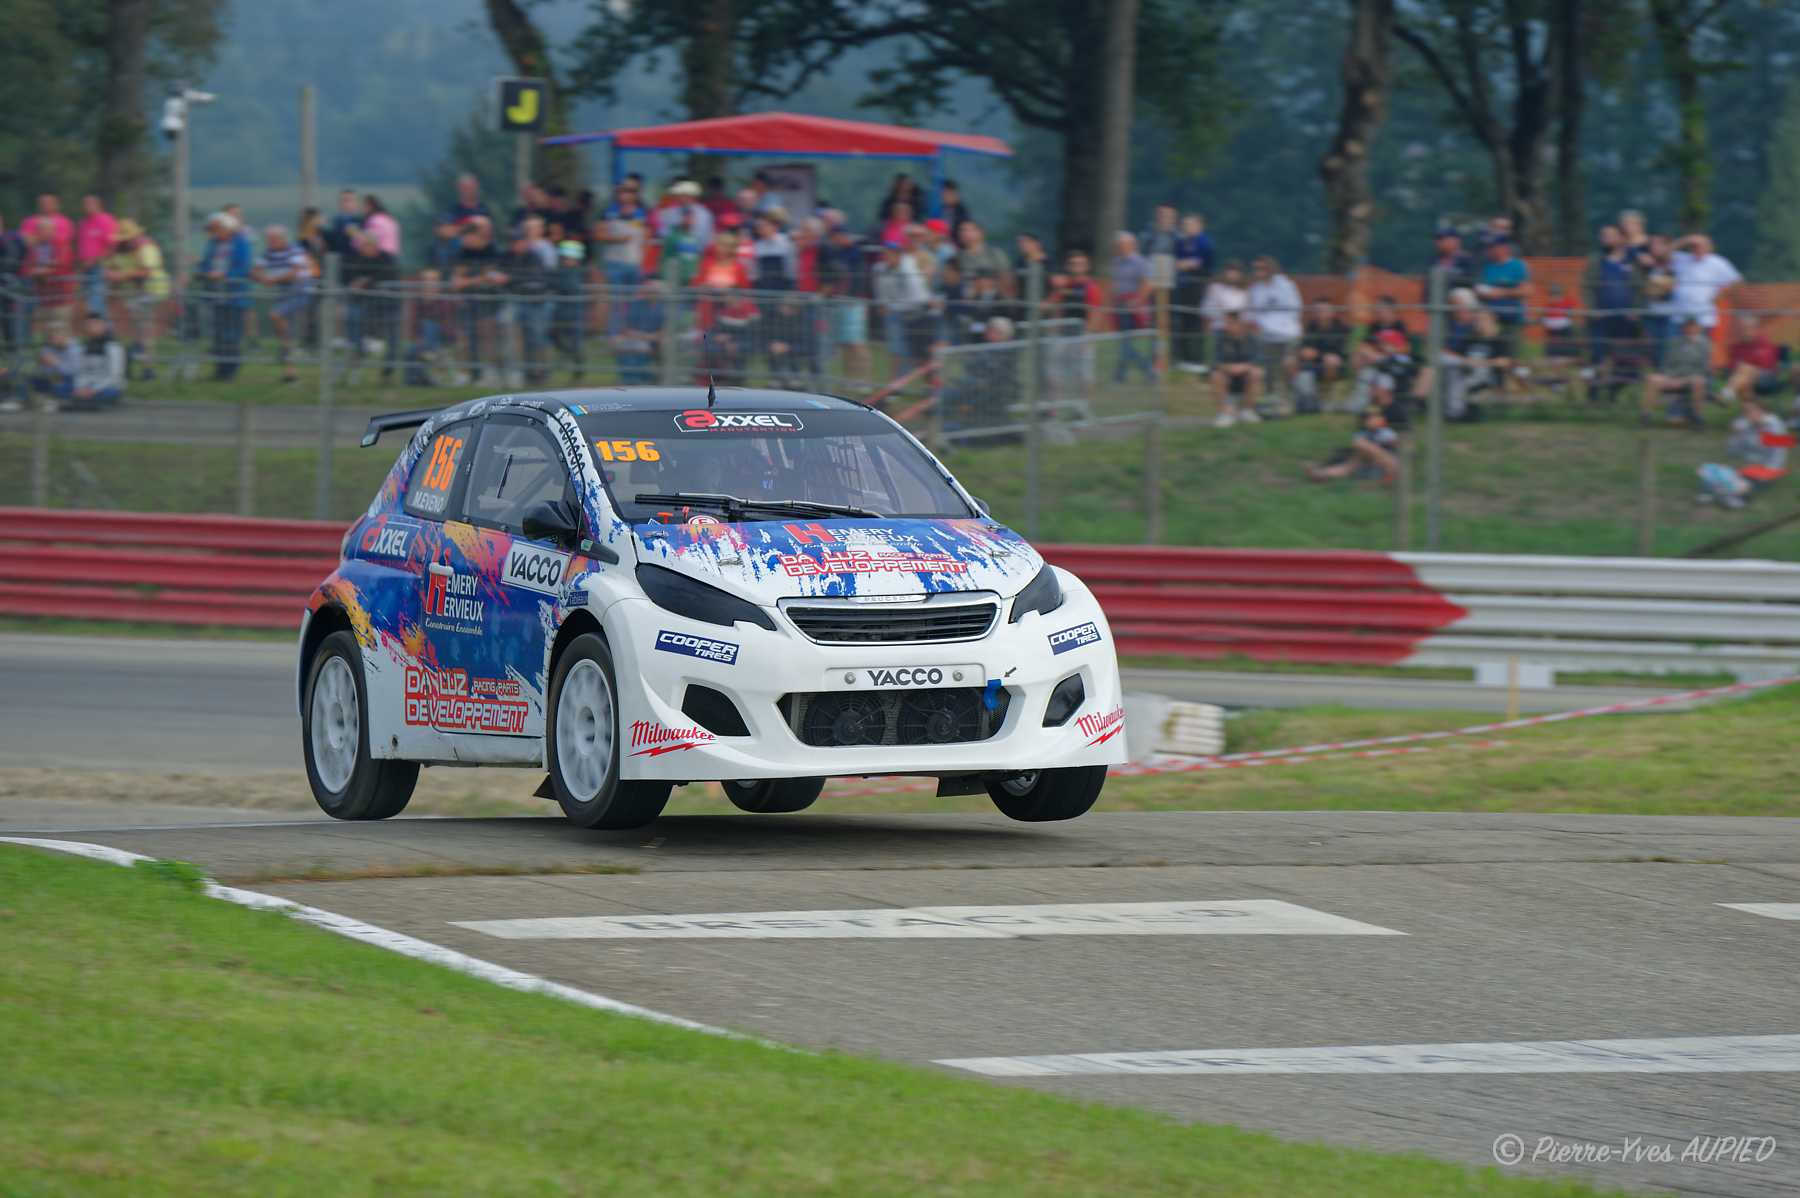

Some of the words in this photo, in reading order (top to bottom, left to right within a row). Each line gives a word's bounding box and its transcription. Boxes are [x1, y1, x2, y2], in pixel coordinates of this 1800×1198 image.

[508, 89, 539, 124] J
[422, 434, 464, 491] 156
[595, 440, 661, 462] 156
[510, 551, 562, 587] YACCO
[780, 553, 815, 567] DA
[824, 550, 870, 561] LUZ
[786, 559, 968, 577] DEVELOPPEMENT
[659, 632, 738, 655] COOPER
[1050, 623, 1097, 646] COOPER
[1075, 632, 1098, 646] TIRES
[694, 647, 734, 662] TIRES
[406, 666, 433, 697] DA
[438, 668, 467, 698] LUZ
[472, 677, 497, 695] RACING
[497, 679, 520, 697] PARTS
[867, 667, 943, 687] YACCO
[405, 697, 529, 733] DEVELOPPEMENT
[630, 719, 719, 748] Milwaukee
